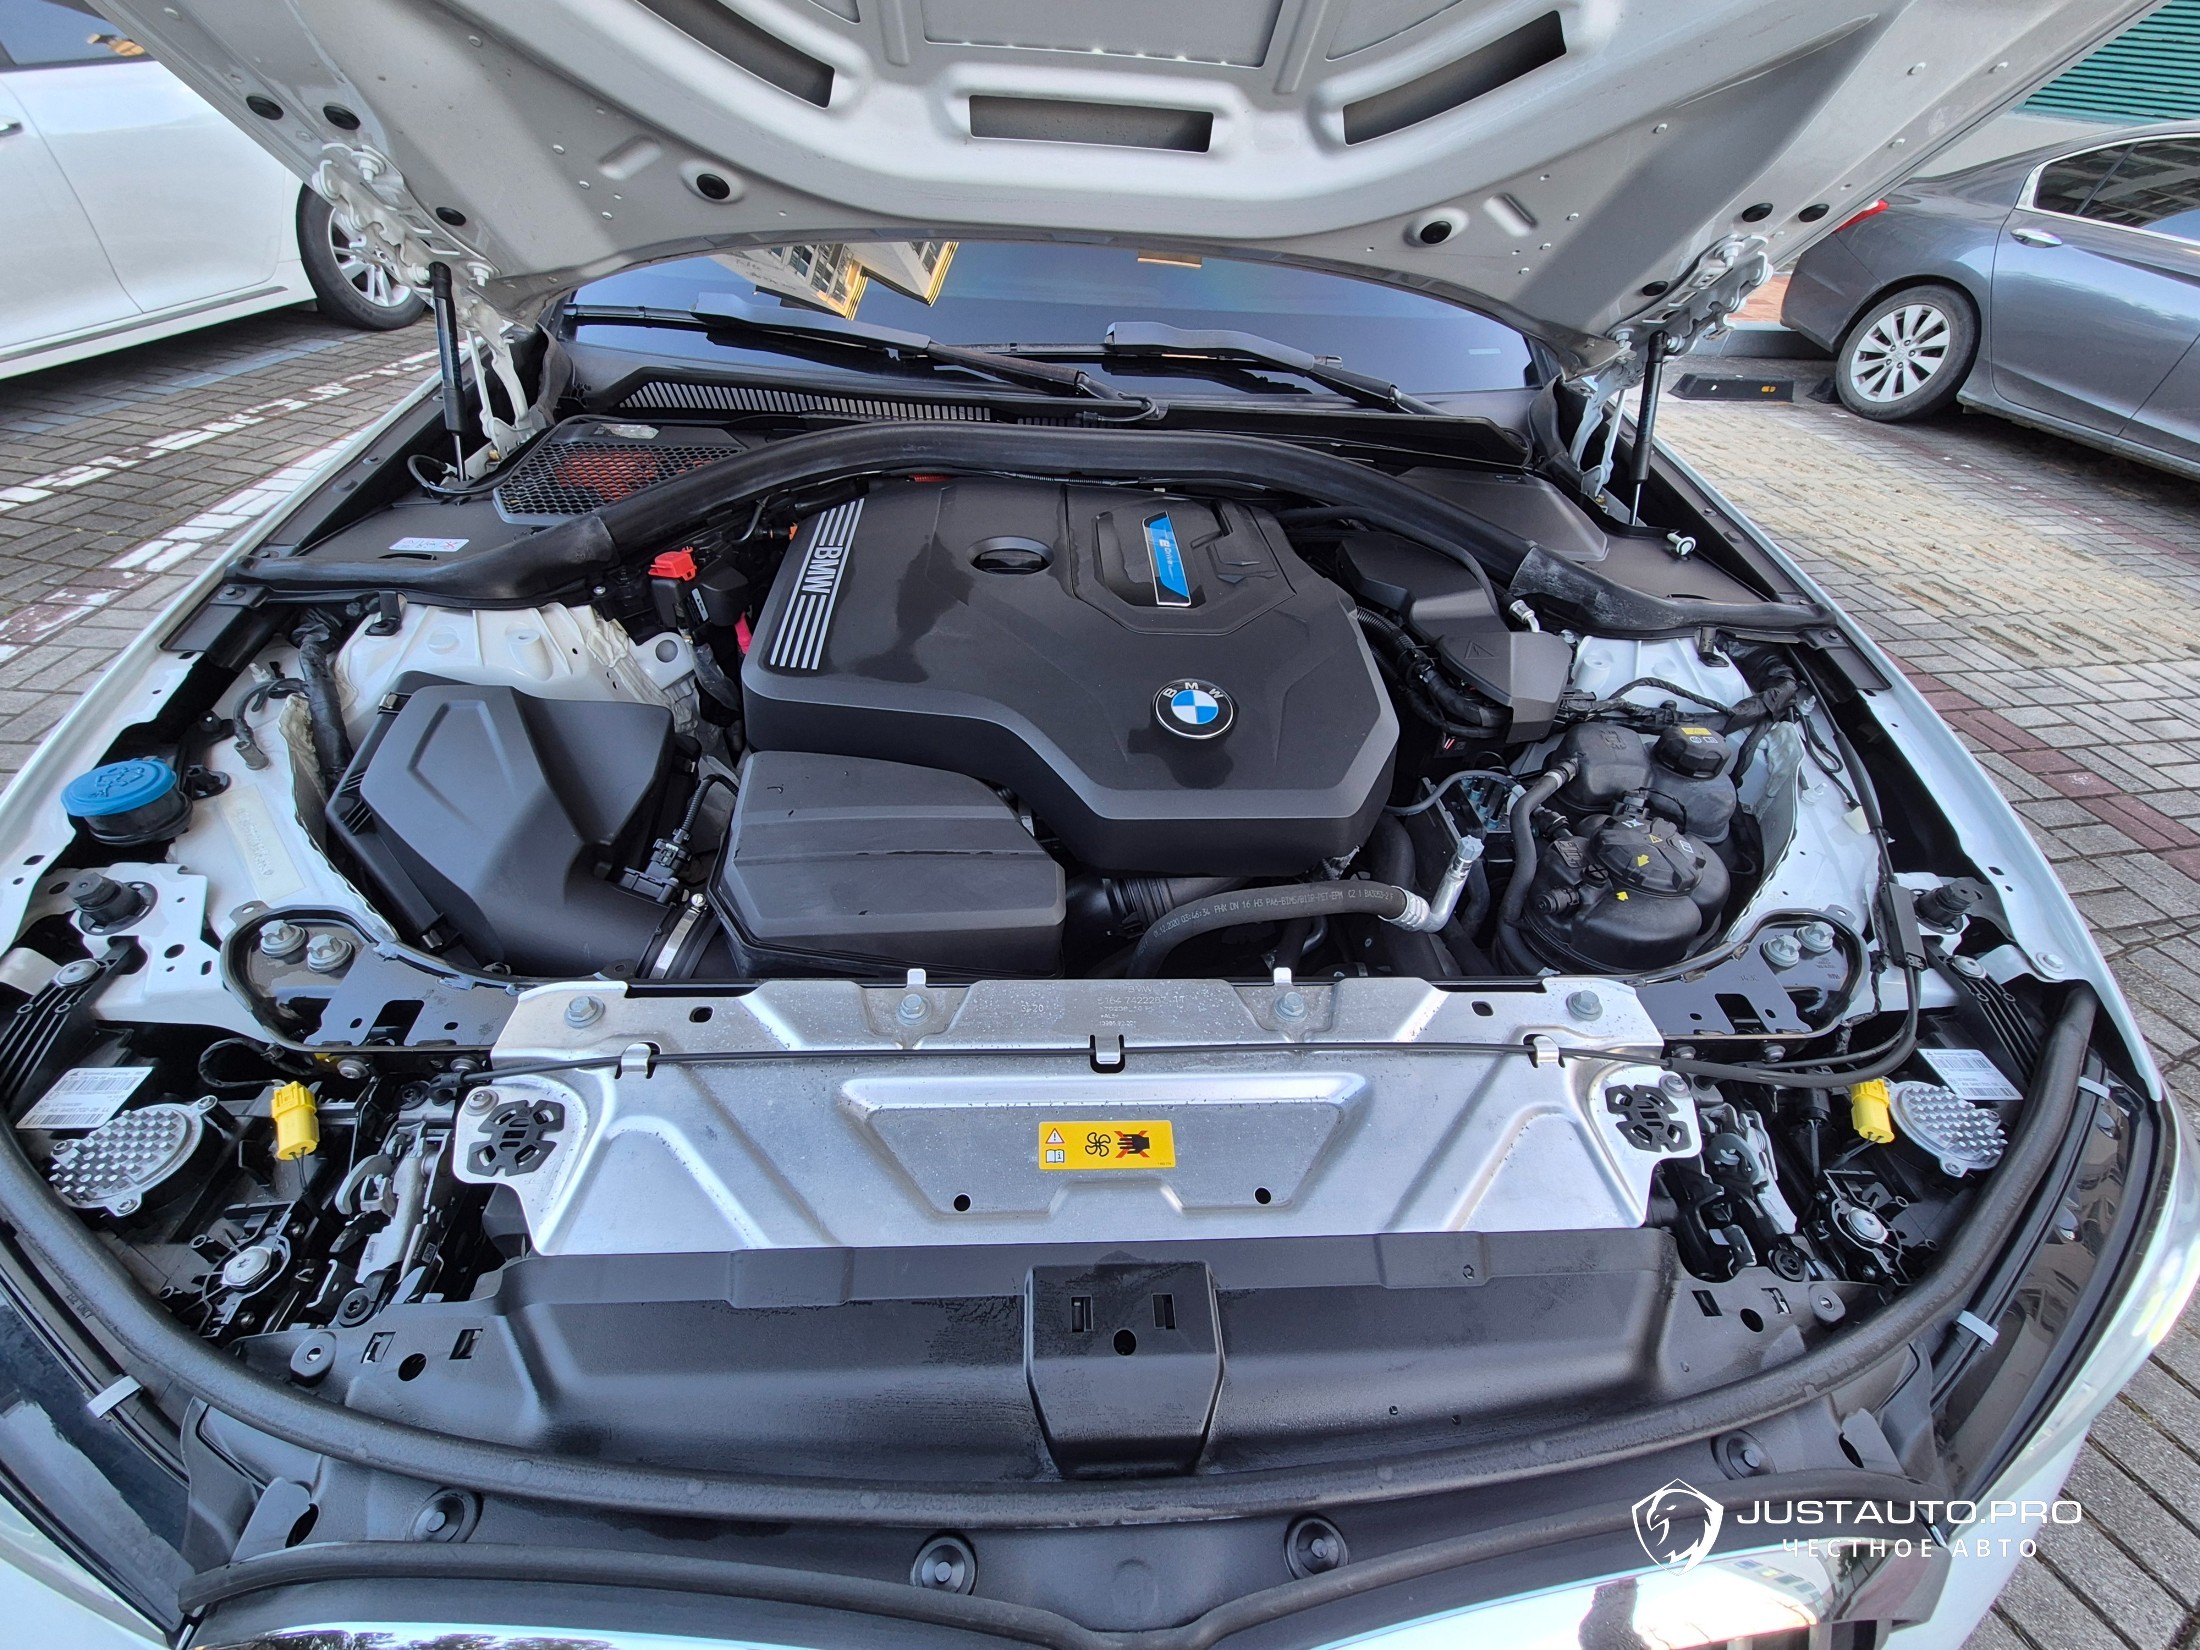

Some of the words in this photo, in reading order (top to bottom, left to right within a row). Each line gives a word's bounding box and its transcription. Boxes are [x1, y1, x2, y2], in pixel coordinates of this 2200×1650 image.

[801, 546, 844, 594] BMW
[1162, 681, 1224, 699] BMW
[1242, 900, 1251, 909] 16
